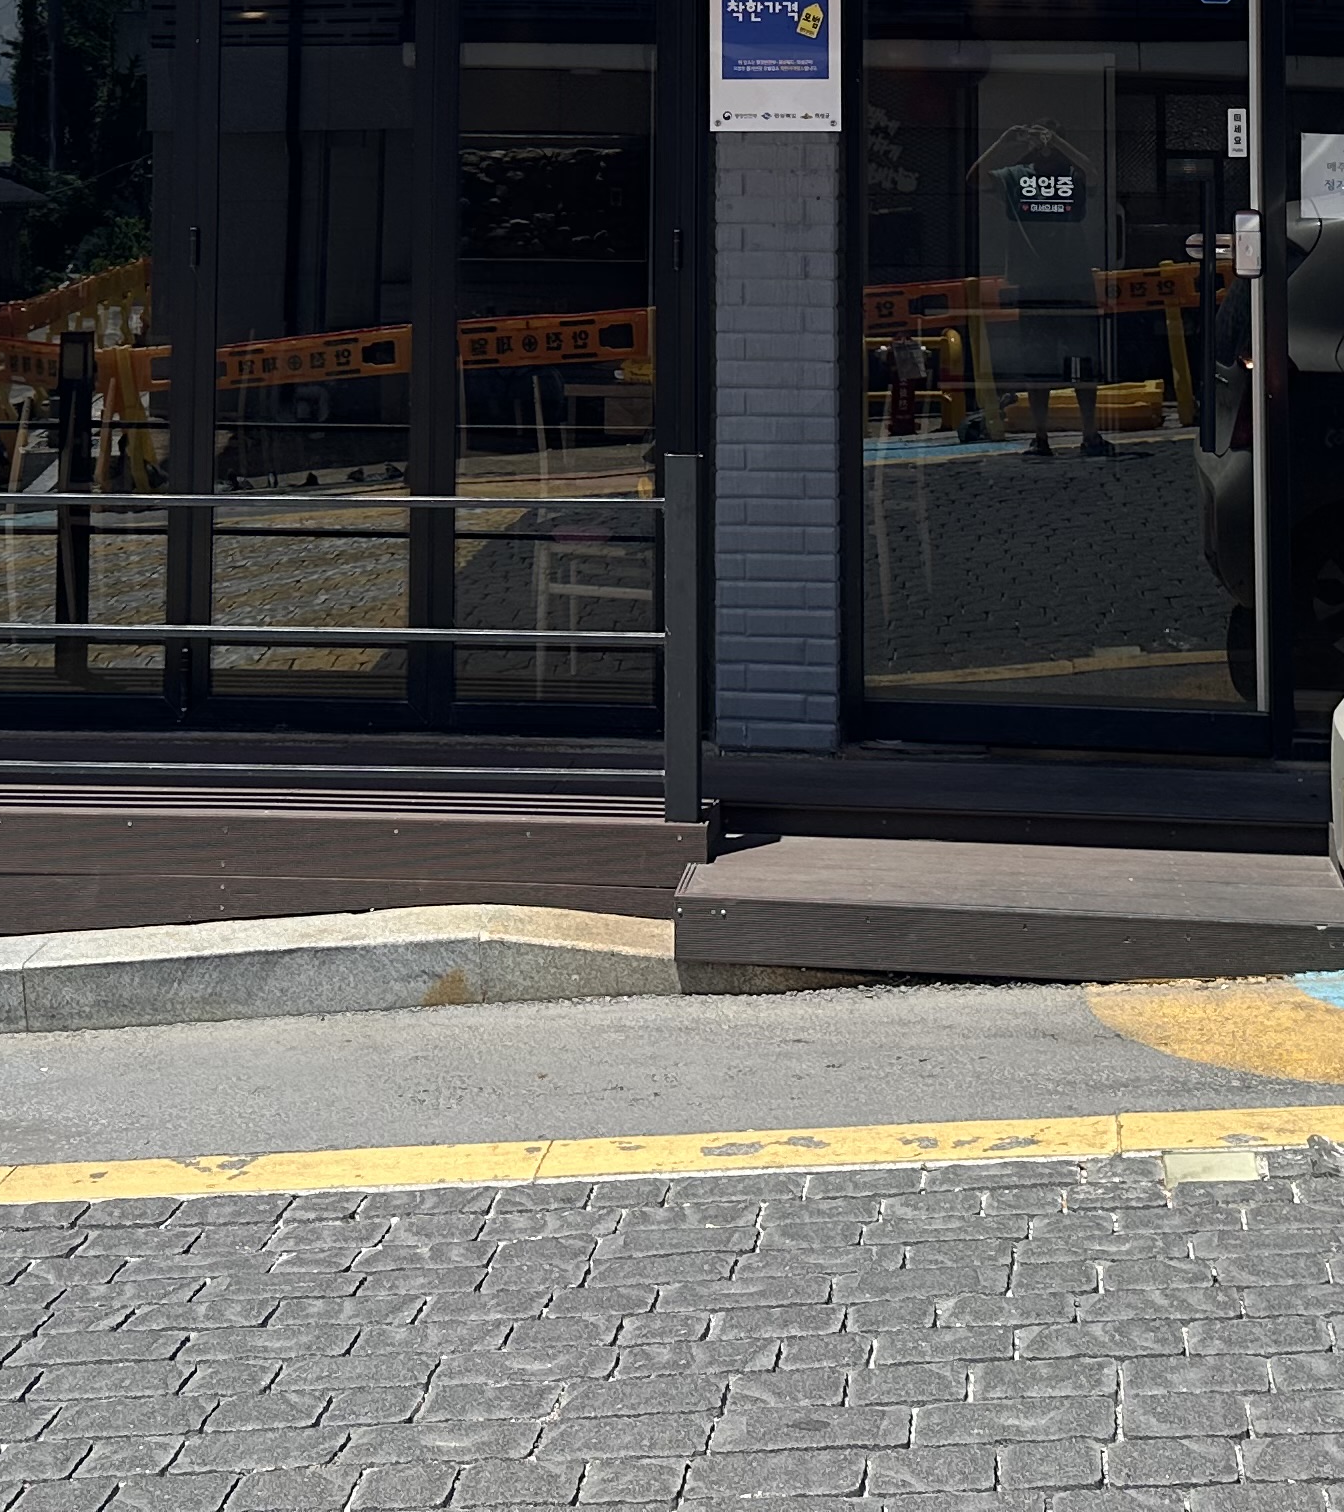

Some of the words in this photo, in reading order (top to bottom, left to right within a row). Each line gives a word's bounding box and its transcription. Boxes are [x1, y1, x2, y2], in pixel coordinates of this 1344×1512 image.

[727, 0, 799, 22] 착한가격
[801, 12, 821, 29] 모범
[1019, 175, 1075, 197] 영업중
